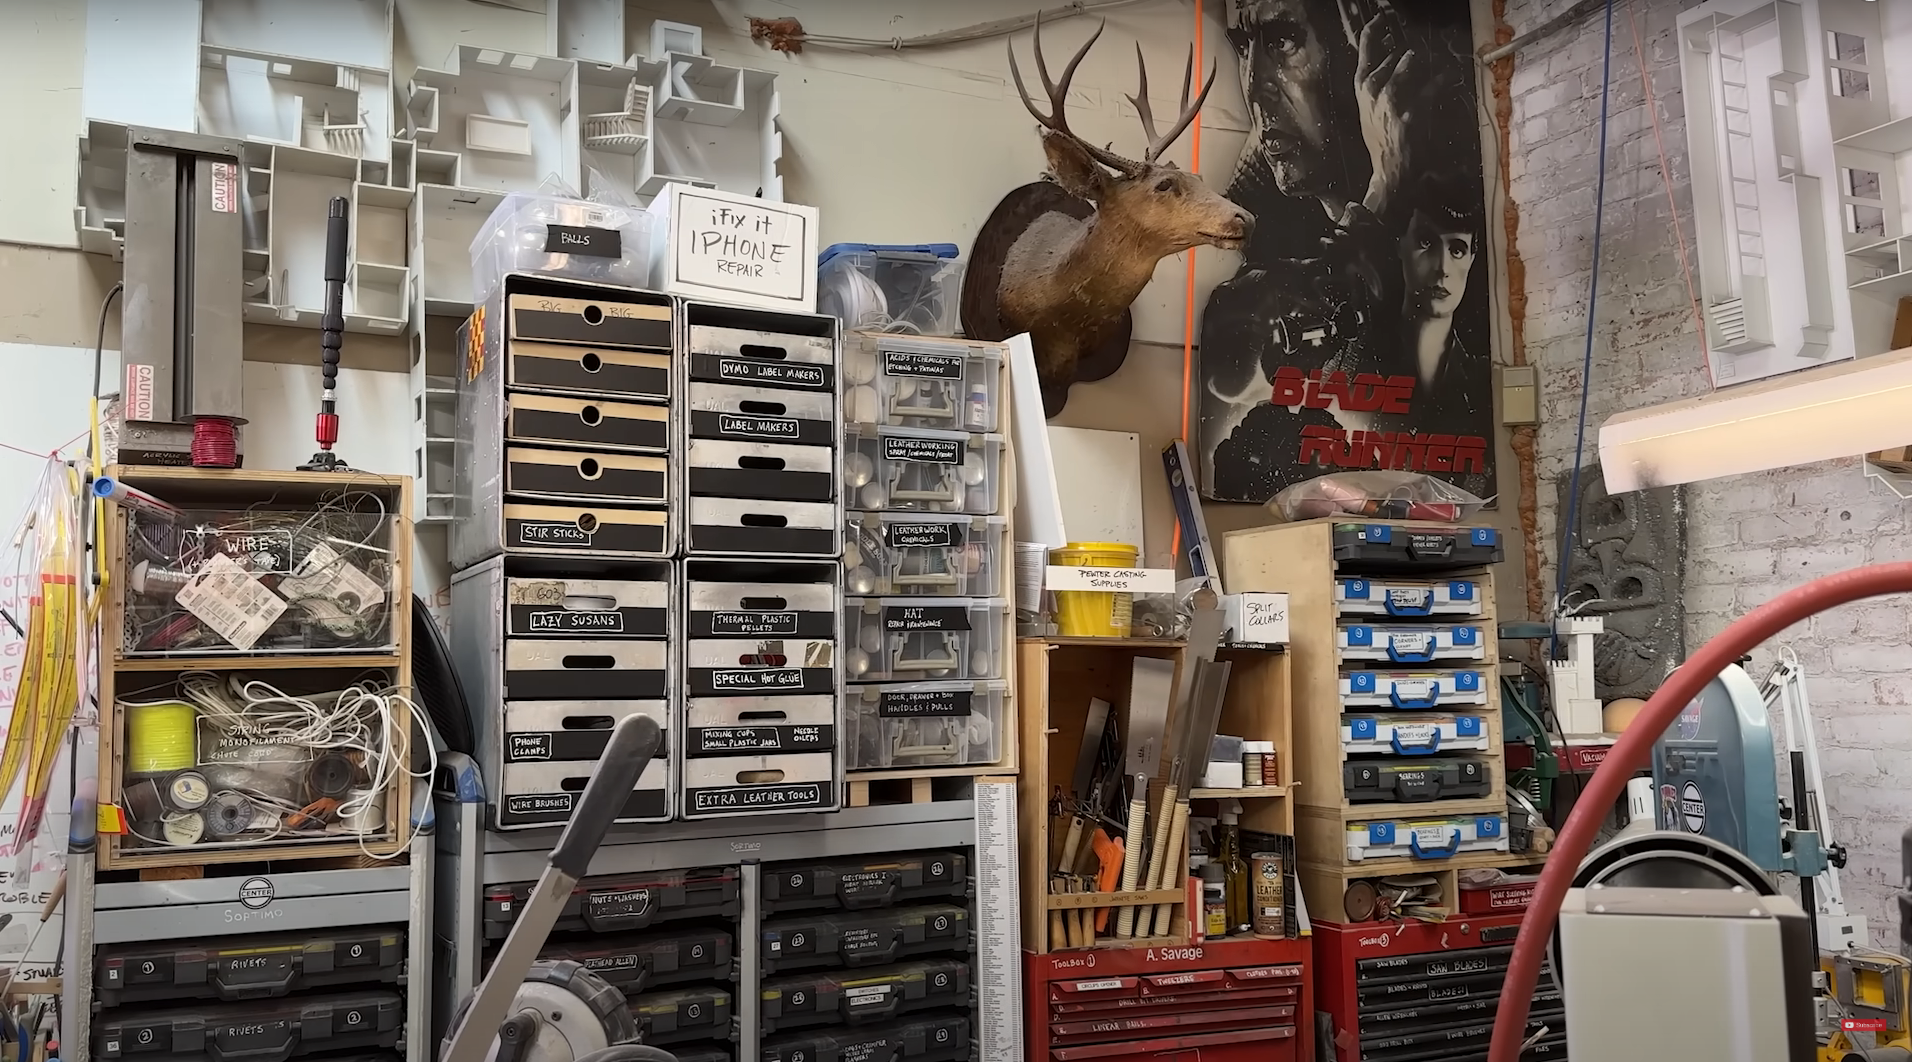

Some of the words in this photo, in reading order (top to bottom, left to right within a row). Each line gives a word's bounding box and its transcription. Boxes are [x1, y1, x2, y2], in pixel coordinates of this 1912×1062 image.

[214, 164, 225, 211] CAUTION
[756, 211, 772, 235] it
[561, 232, 590, 246] BALLS
[691, 229, 792, 263] IPHONE
[717, 259, 763, 278] REPAIR
[722, 362, 750, 375] DYMO
[757, 365, 783, 378] LABEL
[786, 367, 820, 380] MAKERS
[139, 366, 150, 420] CAUTION
[1271, 366, 1416, 414] BLADE
[724, 418, 753, 432] LABEL
[756, 420, 794, 433] MAKERS
[1299, 424, 1487, 474] RUNNER
[525, 526, 549, 539] STIR
[552, 526, 585, 540] STICKS
[1113, 569, 1147, 578] CASTING
[1090, 579, 1128, 589] SUPPLIES
[904, 608, 924, 619] HAT
[1246, 602, 1273, 615] SPLIT
[532, 614, 563, 628] LAZY
[571, 614, 616, 627] SUSANS
[716, 614, 753, 625] THERMAL
[761, 613, 791, 624] PLASTIC
[1248, 611, 1284, 626] COLLARS
[741, 623, 774, 632] PELLETS
[715, 673, 756, 685] SPECIAL
[761, 672, 775, 684] HOT
[887, 703, 923, 713] HANDLES
[931, 703, 953, 711] PULLS
[227, 723, 270, 736] STRING
[704, 730, 733, 739] MIXING
[736, 729, 756, 738] CUPS
[793, 726, 819, 735] NEEDLE
[514, 737, 542, 746] PHONE
[704, 740, 727, 748] SMALL
[728, 738, 757, 748] PLASTIC
[760, 738, 777, 747] JARS
[210, 750, 239, 760] CHUTE
[513, 746, 546, 756] CLAMPS
[511, 799, 532, 809] WIRE
[534, 798, 569, 808] BRUSHES
[698, 793, 737, 807] EXTRA
[743, 791, 785, 804] LEATHER
[788, 789, 815, 800] TOOLS
[1682, 801, 1705, 814] CENTER
[1146, 949, 1158, 962] A.
[1161, 947, 1204, 961] Savage
[231, 957, 267, 970] RIVETS
[1430, 963, 1448, 974] SAW
[1157, 975, 1195, 986] TWEEZERS
[229, 1024, 264, 1037] RIVETS
